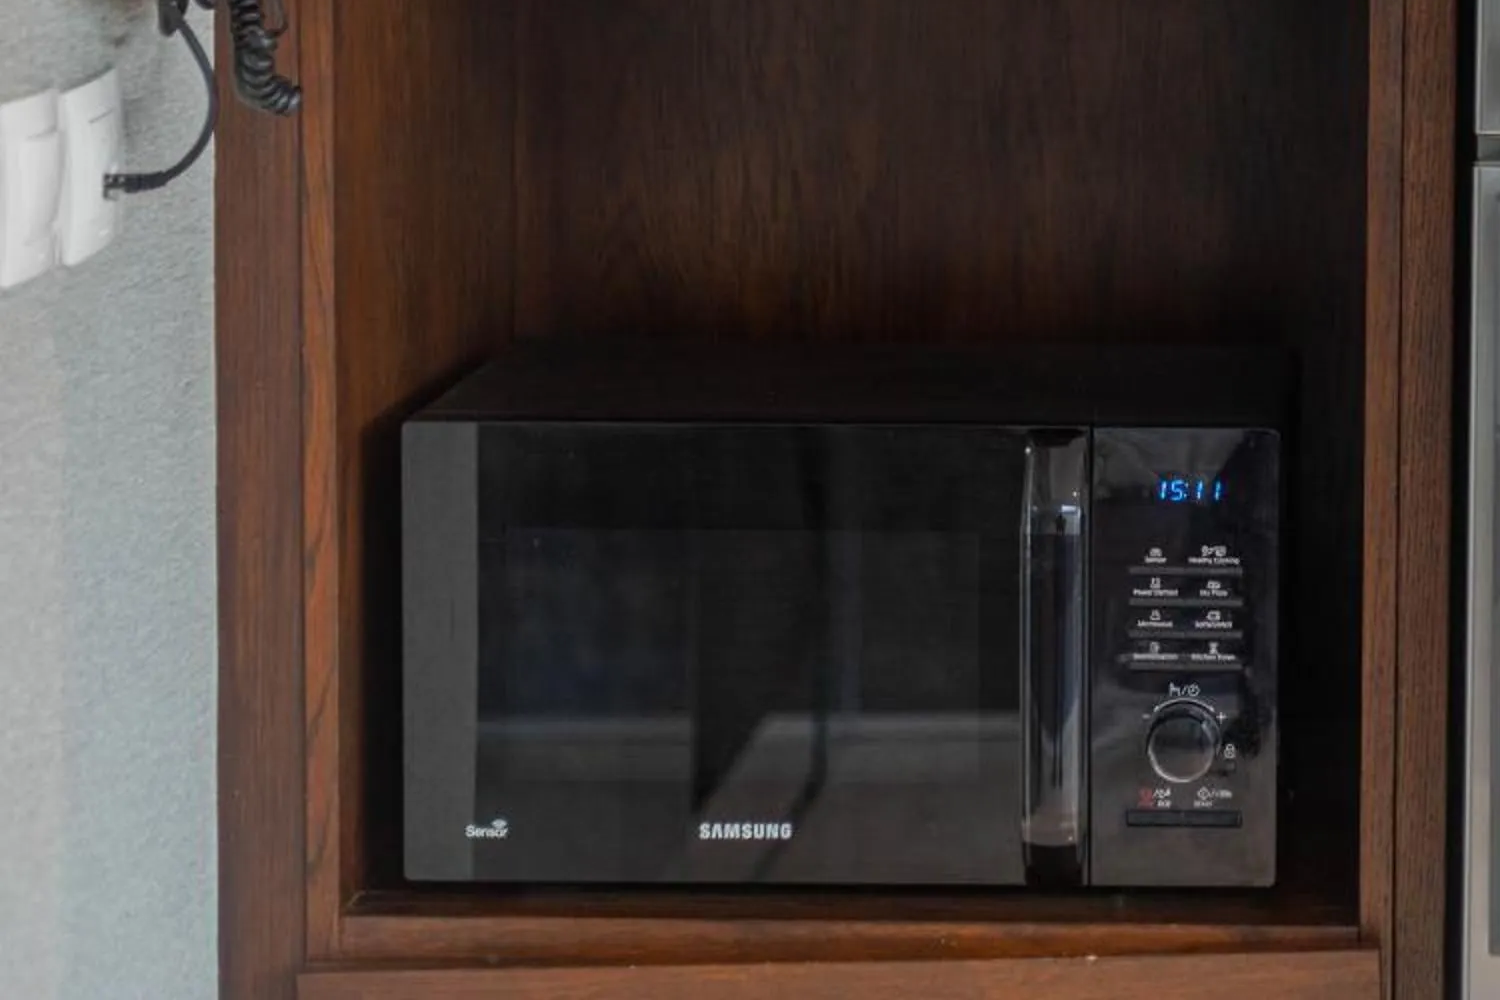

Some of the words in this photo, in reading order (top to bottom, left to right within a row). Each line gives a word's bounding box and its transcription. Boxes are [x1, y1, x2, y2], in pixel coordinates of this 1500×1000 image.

[1158, 479, 1222, 501] 15:11
[464, 824, 508, 838] Sensor
[699, 823, 792, 839] SAMSUNG
